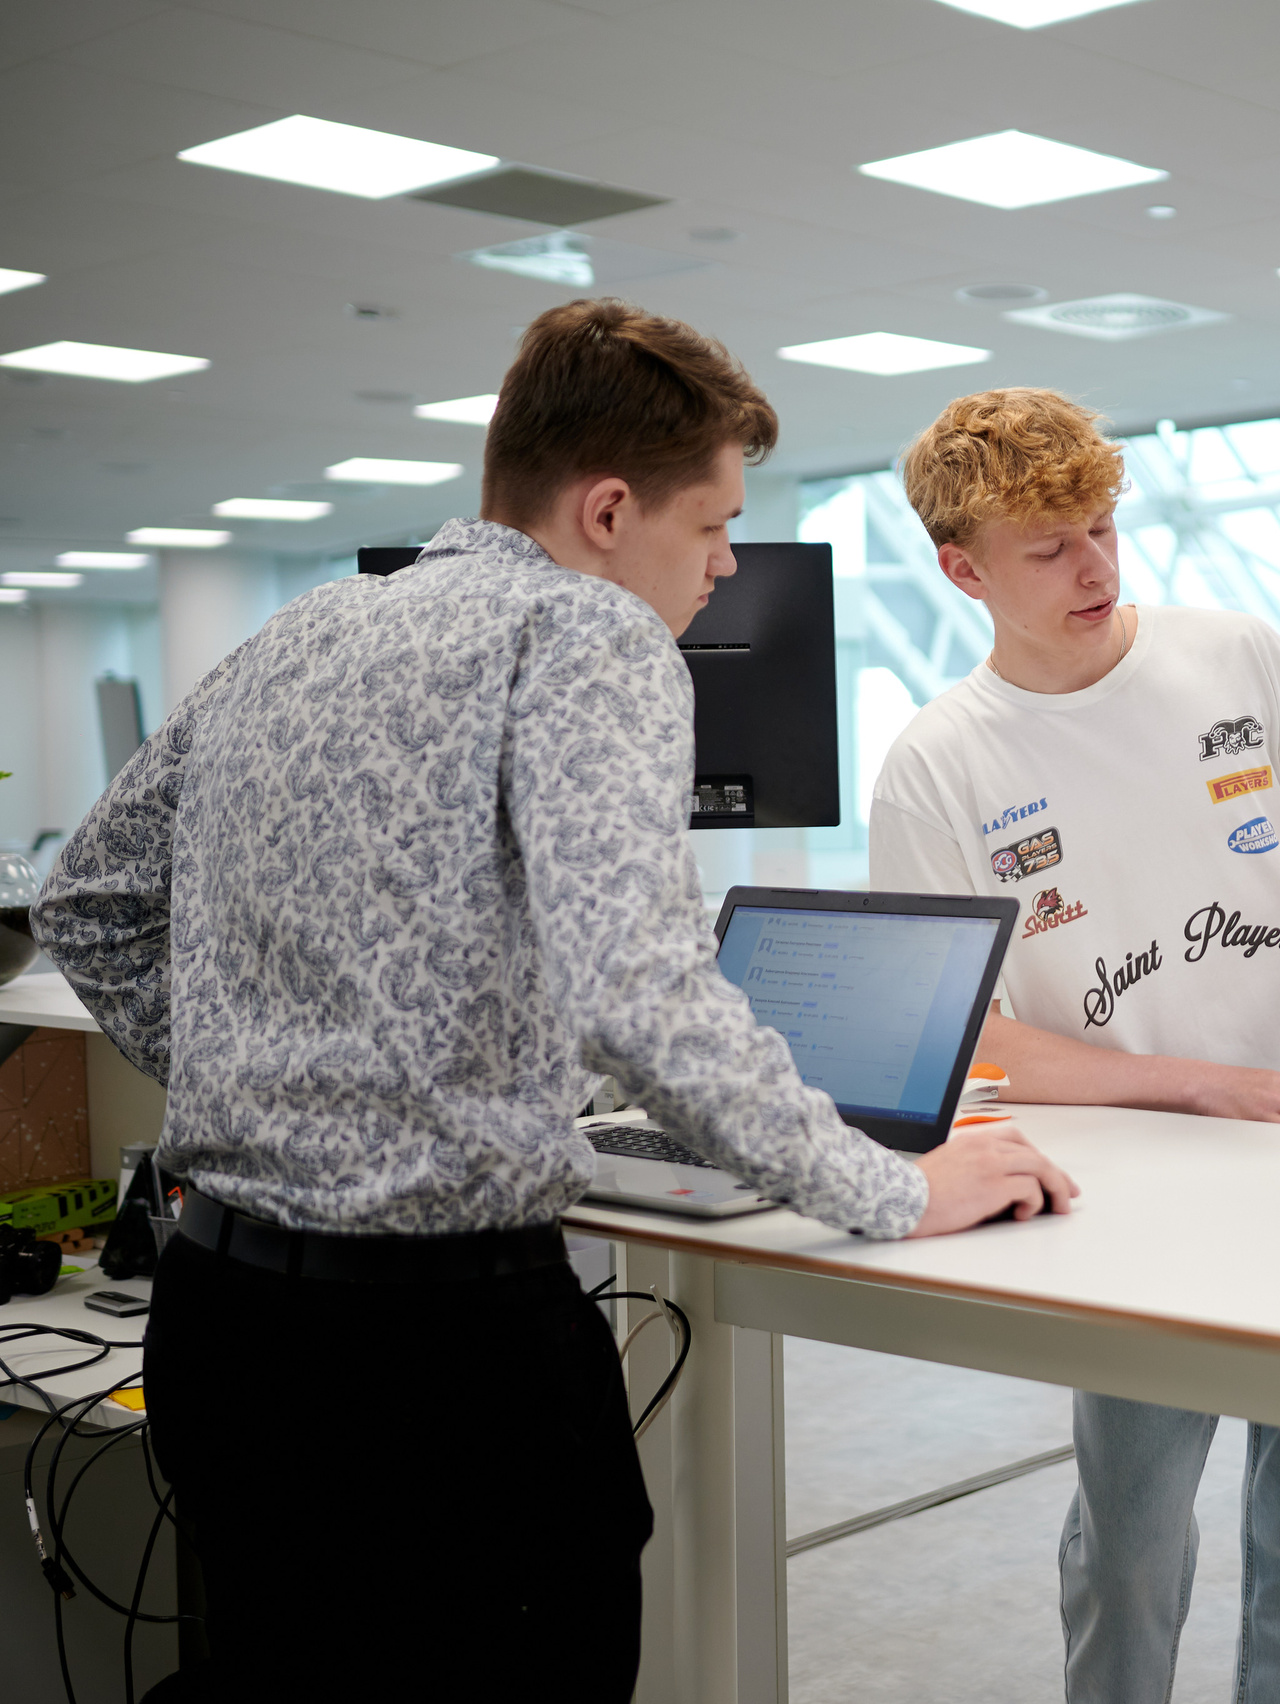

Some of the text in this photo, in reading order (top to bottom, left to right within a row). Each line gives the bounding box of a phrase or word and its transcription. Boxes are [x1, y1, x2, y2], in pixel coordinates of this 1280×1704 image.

[1213, 770, 1269, 800] PLAYERS
[1017, 831, 1055, 855] GAS
[1021, 842, 1058, 862] PLAYERS
[994, 853, 1013, 870] PCG
[1023, 849, 1060, 874] 735
[1083, 939, 1163, 1030] Saint
